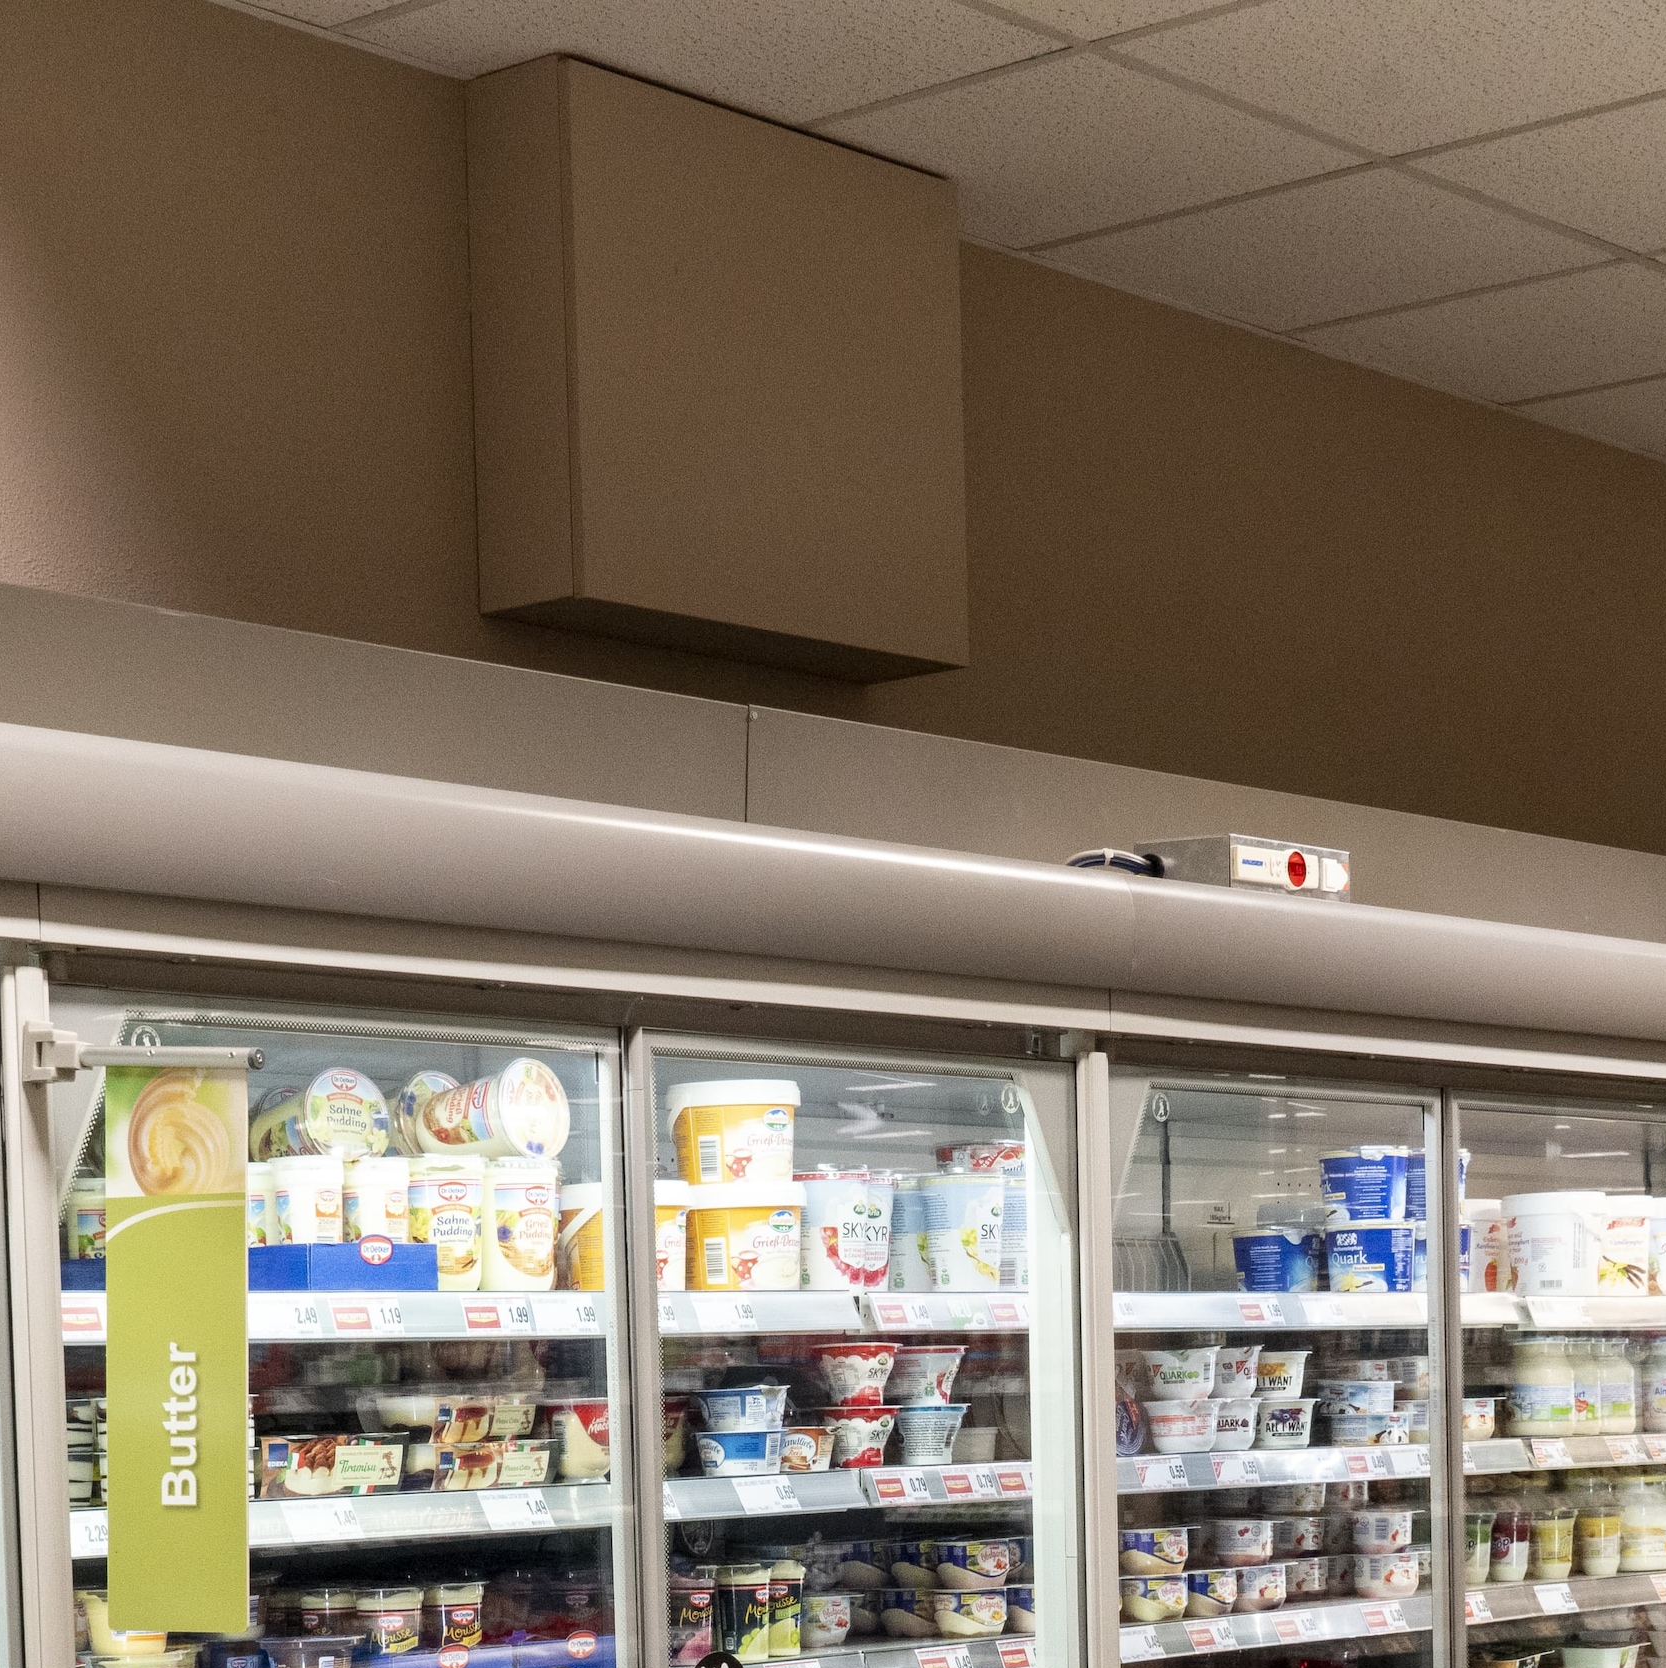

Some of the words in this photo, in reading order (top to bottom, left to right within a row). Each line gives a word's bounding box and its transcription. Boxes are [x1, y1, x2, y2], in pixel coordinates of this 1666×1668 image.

[329, 1104, 366, 1120] Sahne
[326, 1114, 368, 1134] Pudding
[436, 1213, 471, 1229] Sahne
[433, 1224, 473, 1240] Pudding
[160, 1342, 199, 1507] Butter
